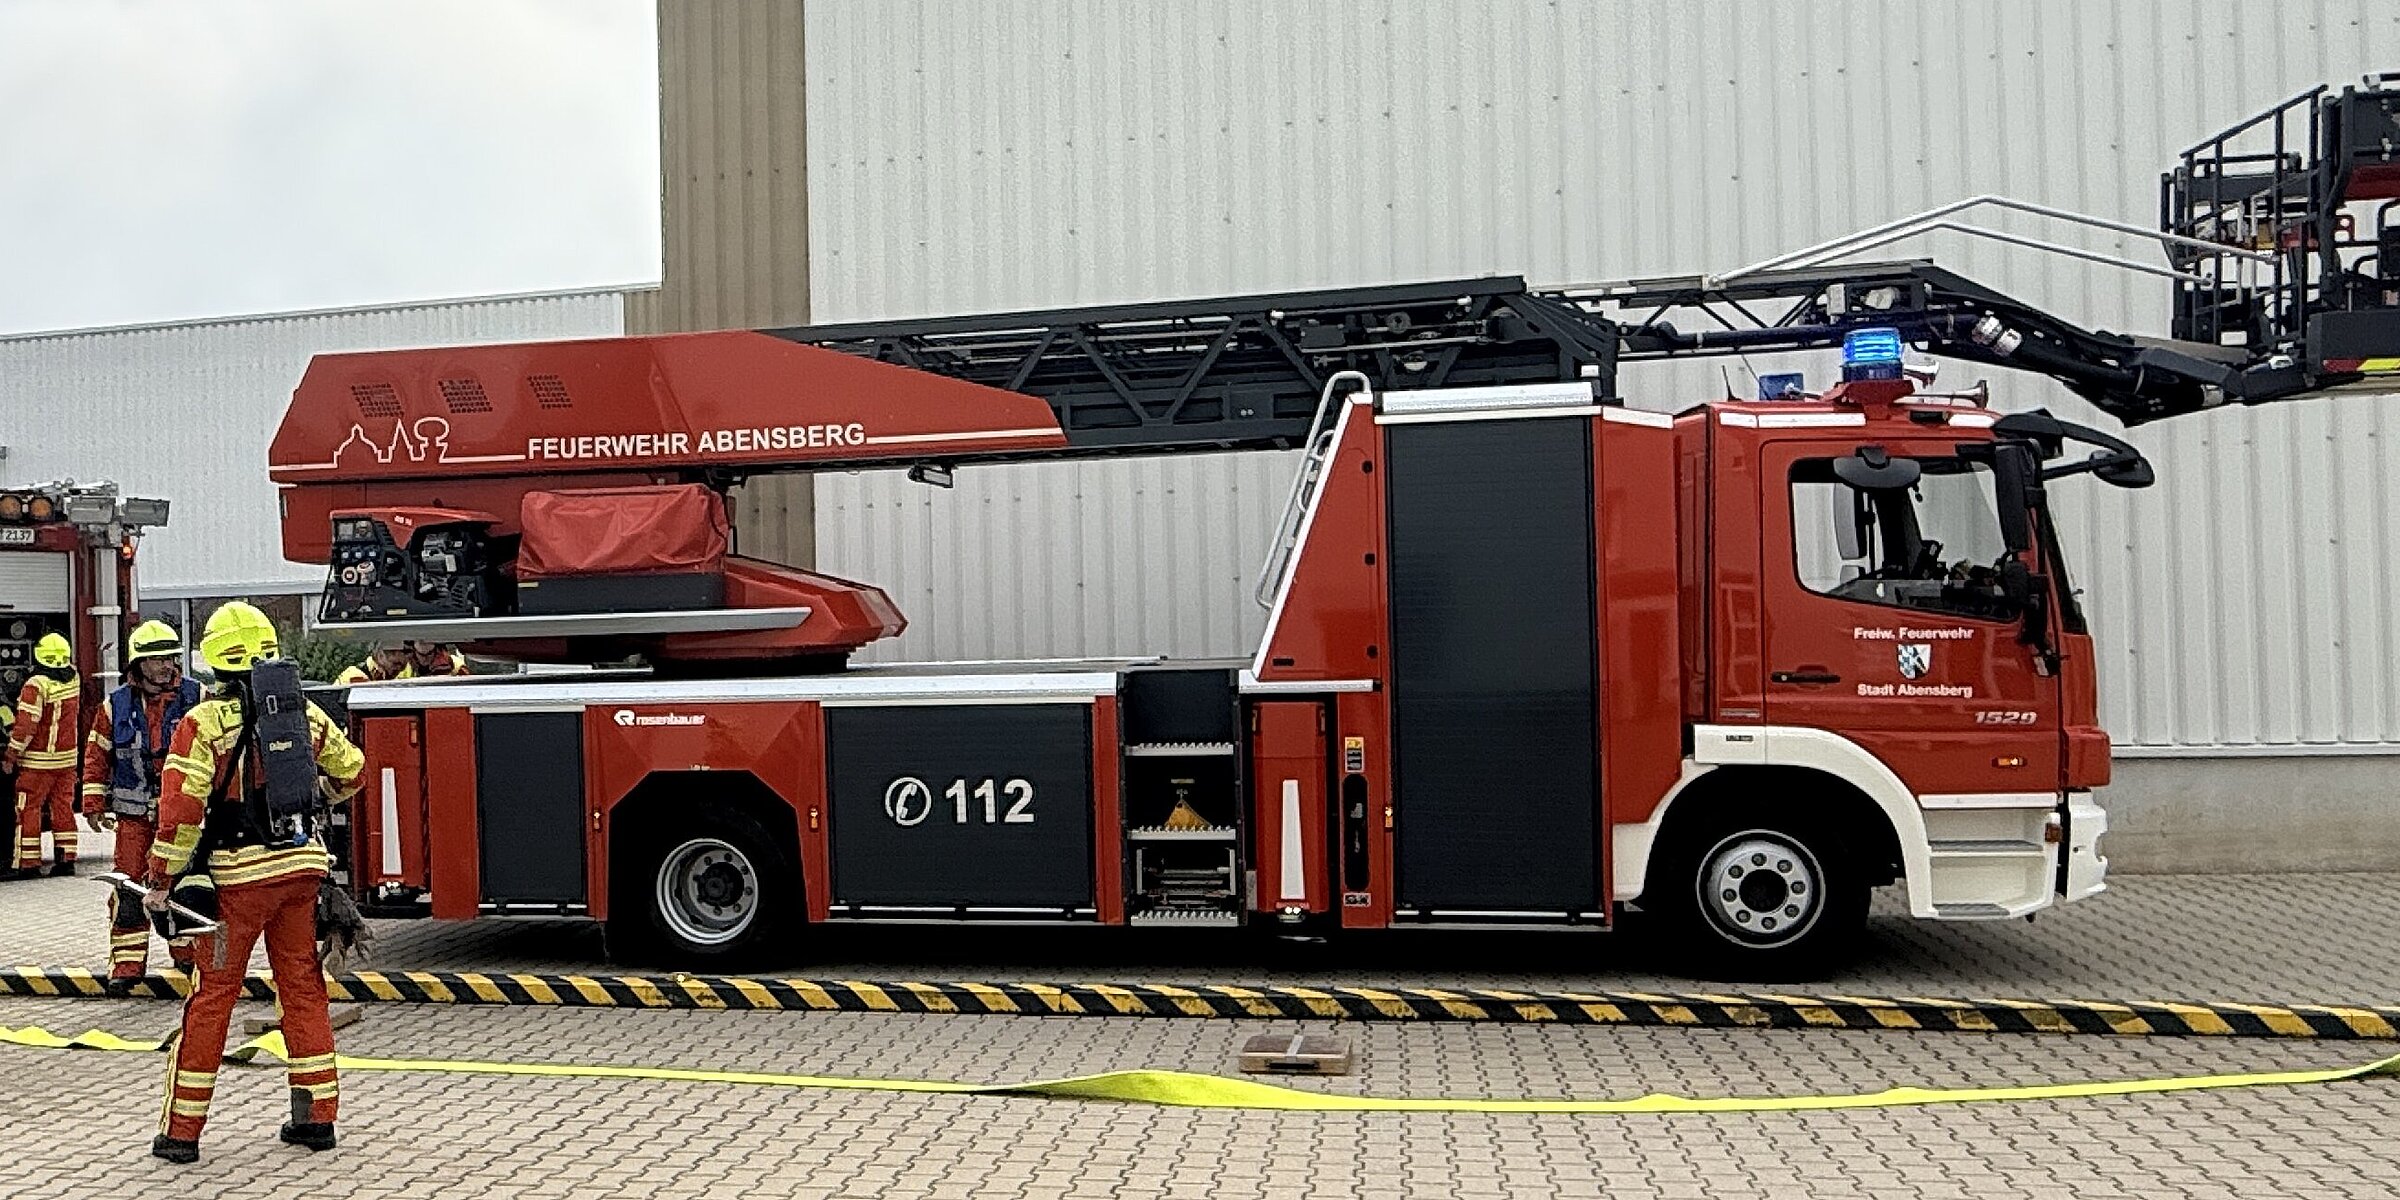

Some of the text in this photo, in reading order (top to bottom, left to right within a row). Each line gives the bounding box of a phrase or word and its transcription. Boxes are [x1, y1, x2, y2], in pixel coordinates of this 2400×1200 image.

[528, 424, 865, 459] FEUERWEHR ABENSBERG
[5, 530, 31, 541] 2137
[1854, 627, 1974, 639] Freiw. Feuerwehr
[1858, 684, 1973, 698] Stadt Abensberg
[636, 712, 706, 726] rosenbauer
[1975, 711, 2037, 724] 1529
[946, 779, 1035, 823] 112
